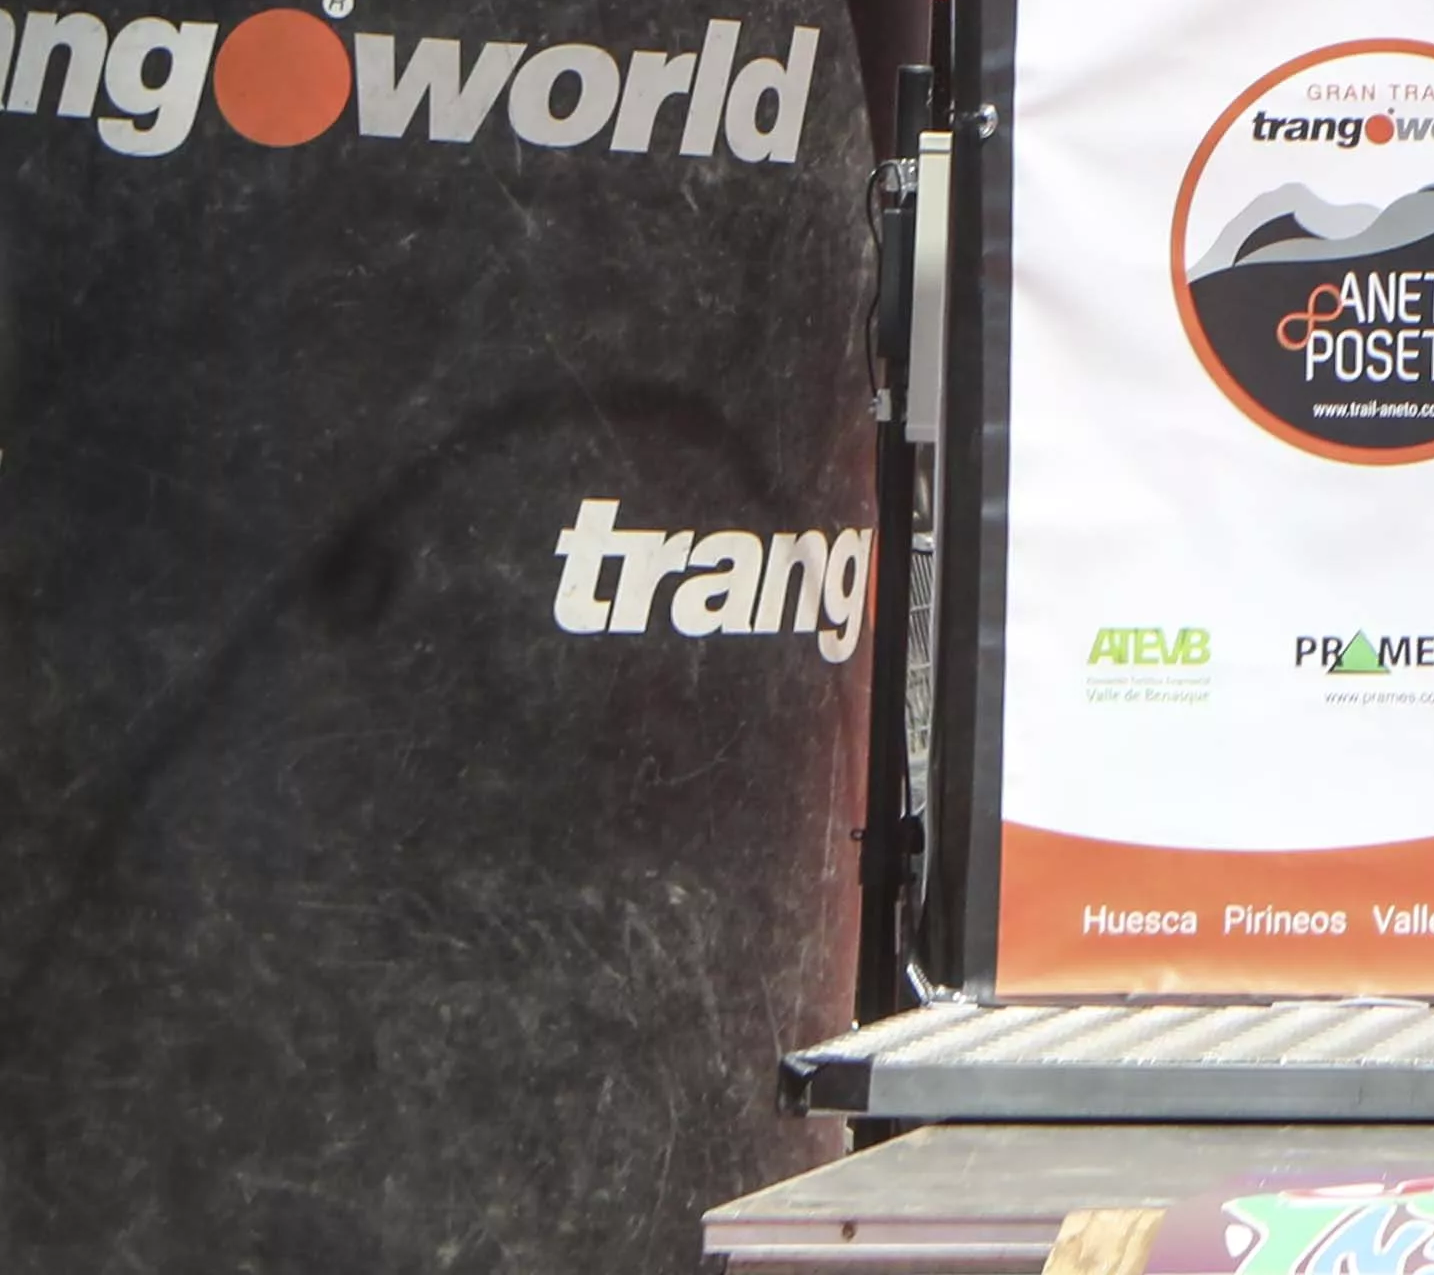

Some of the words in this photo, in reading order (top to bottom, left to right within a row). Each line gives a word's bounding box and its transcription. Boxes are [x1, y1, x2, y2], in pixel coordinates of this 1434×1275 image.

[0, 7, 820, 164] ngoworld
[1306, 83, 1377, 102] GRAN
[1086, 688, 1120, 703] Valle
[1124, 687, 1140, 702] de
[1145, 687, 1211, 705] Benasque
[1082, 904, 1198, 935] Huesca
[1224, 904, 1347, 936] Pirineos
